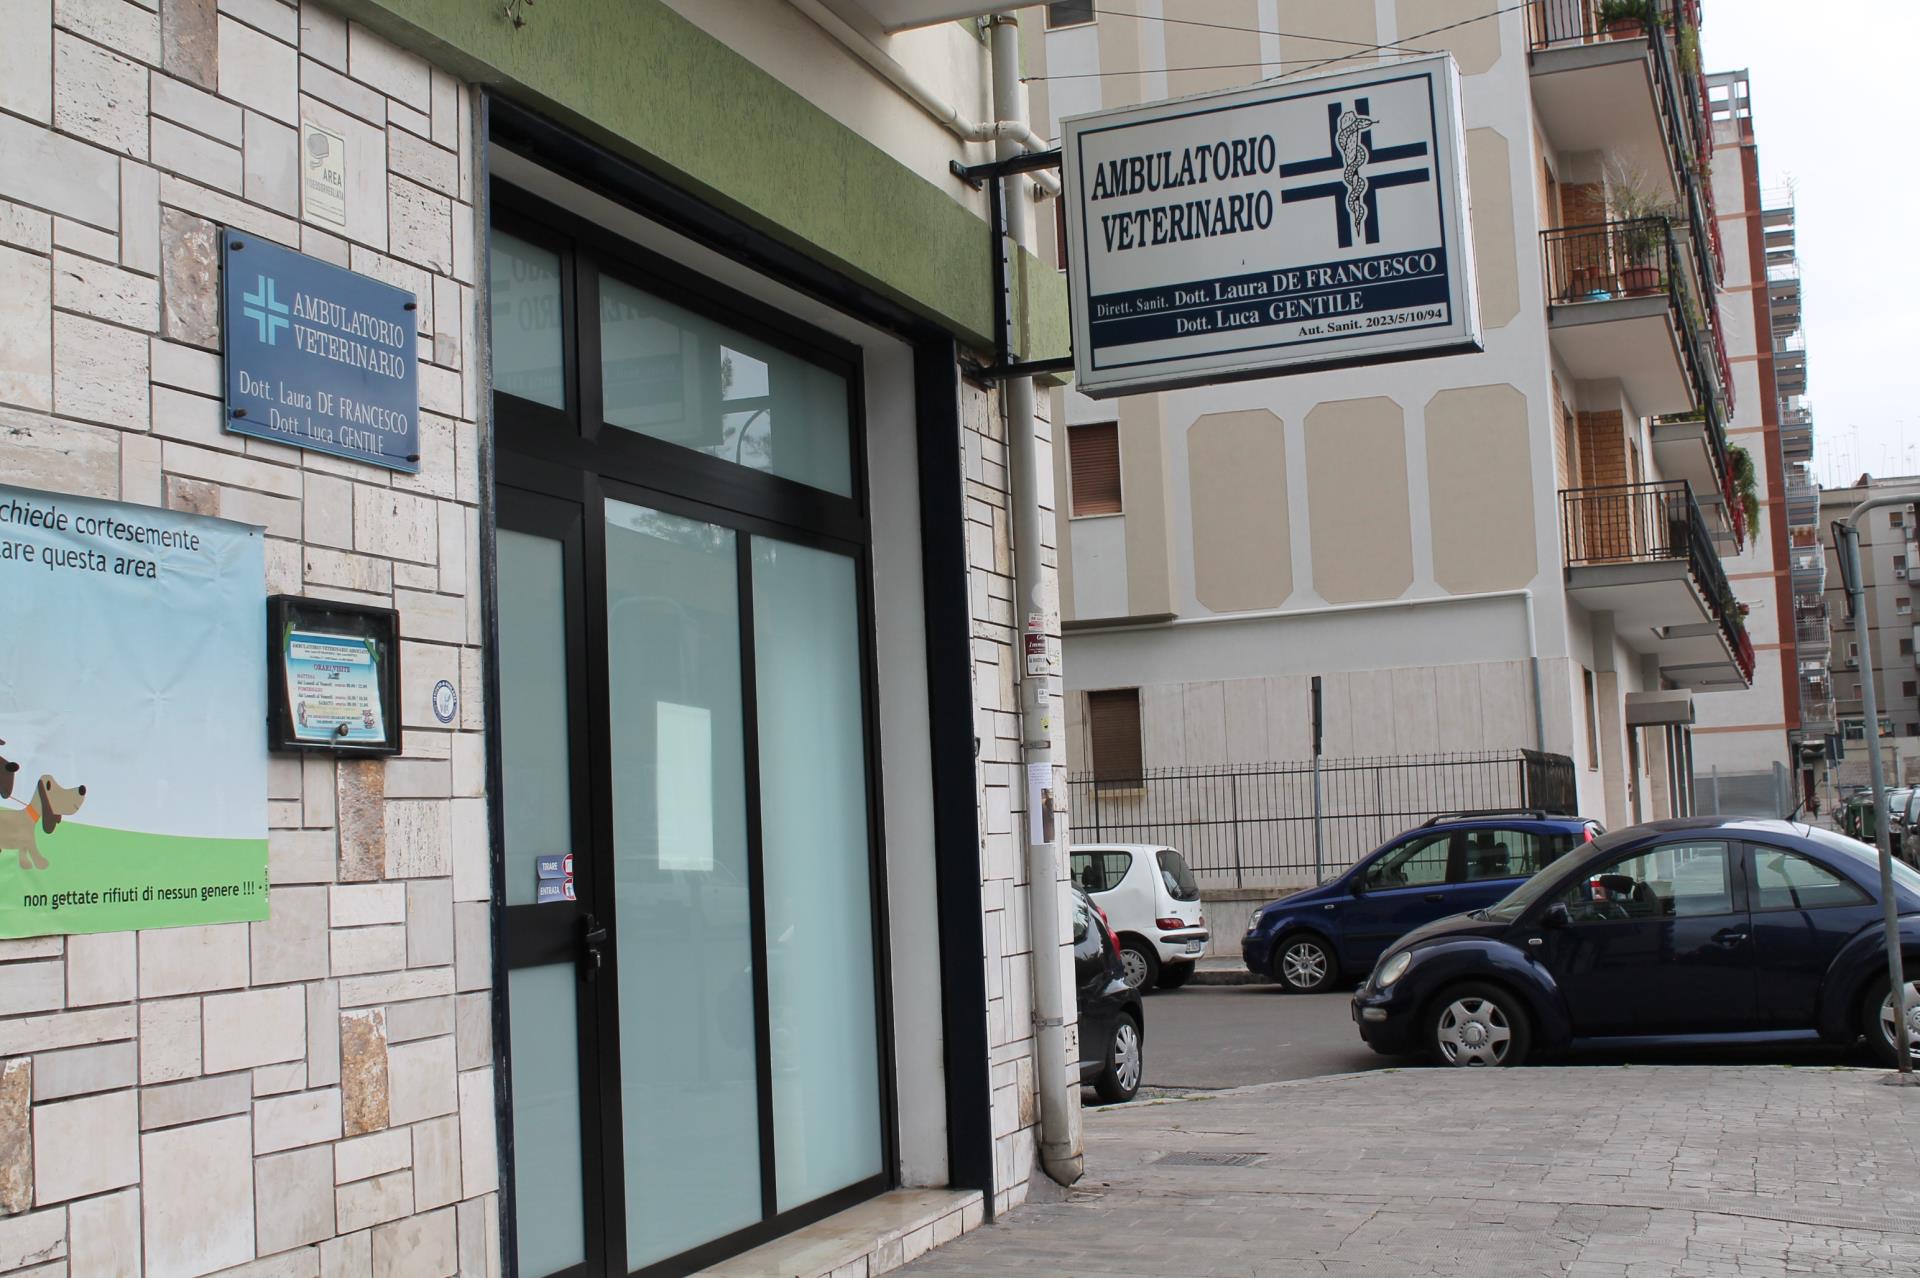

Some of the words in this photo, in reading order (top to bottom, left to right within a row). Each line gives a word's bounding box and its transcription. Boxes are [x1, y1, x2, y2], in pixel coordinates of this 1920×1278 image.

[323, 168, 342, 187] AREA
[1091, 134, 1276, 201] AMBULATORIO
[1101, 189, 1273, 253] VETERINARIO
[1096, 302, 1133, 318] Dirett.
[1136, 297, 1169, 313] Sanit.
[1174, 288, 1210, 307] Dott.
[1214, 280, 1267, 301] Laura
[1272, 272, 1301, 294] DE
[1305, 252, 1437, 289] FRANCESCO
[293, 292, 404, 349] AMBULATORIO
[1176, 316, 1212, 334] Dott.
[1216, 307, 1260, 328] Luca
[1269, 291, 1364, 321] GENTILE
[1298, 324, 1325, 337] Aut.
[1327, 319, 1362, 333] Sanit.
[1366, 308, 1442, 329] 2023/5/10/94
[294, 324, 405, 380] VETERINARIO
[240, 371, 274, 401] Dott.
[280, 381, 312, 411] Laura
[318, 392, 334, 416] DE
[340, 398, 408, 436] FRANCESCO
[270, 408, 302, 436] Dott.
[308, 417, 333, 444] Luca
[340, 426, 384, 457] GENTILE
[75, 516, 200, 551] cortesemente
[0, 541, 35, 562] are
[42, 545, 107, 572] questa
[114, 556, 157, 579] area
[542, 862, 558, 871] TIRARE
[24, 891, 47, 908] non
[52, 890, 99, 910] gettate
[103, 887, 138, 904] rifiuti
[142, 886, 153, 901] di
[157, 884, 198, 900] nessun
[201, 883, 239, 901] genere
[540, 886, 560, 896] ENTRATA
